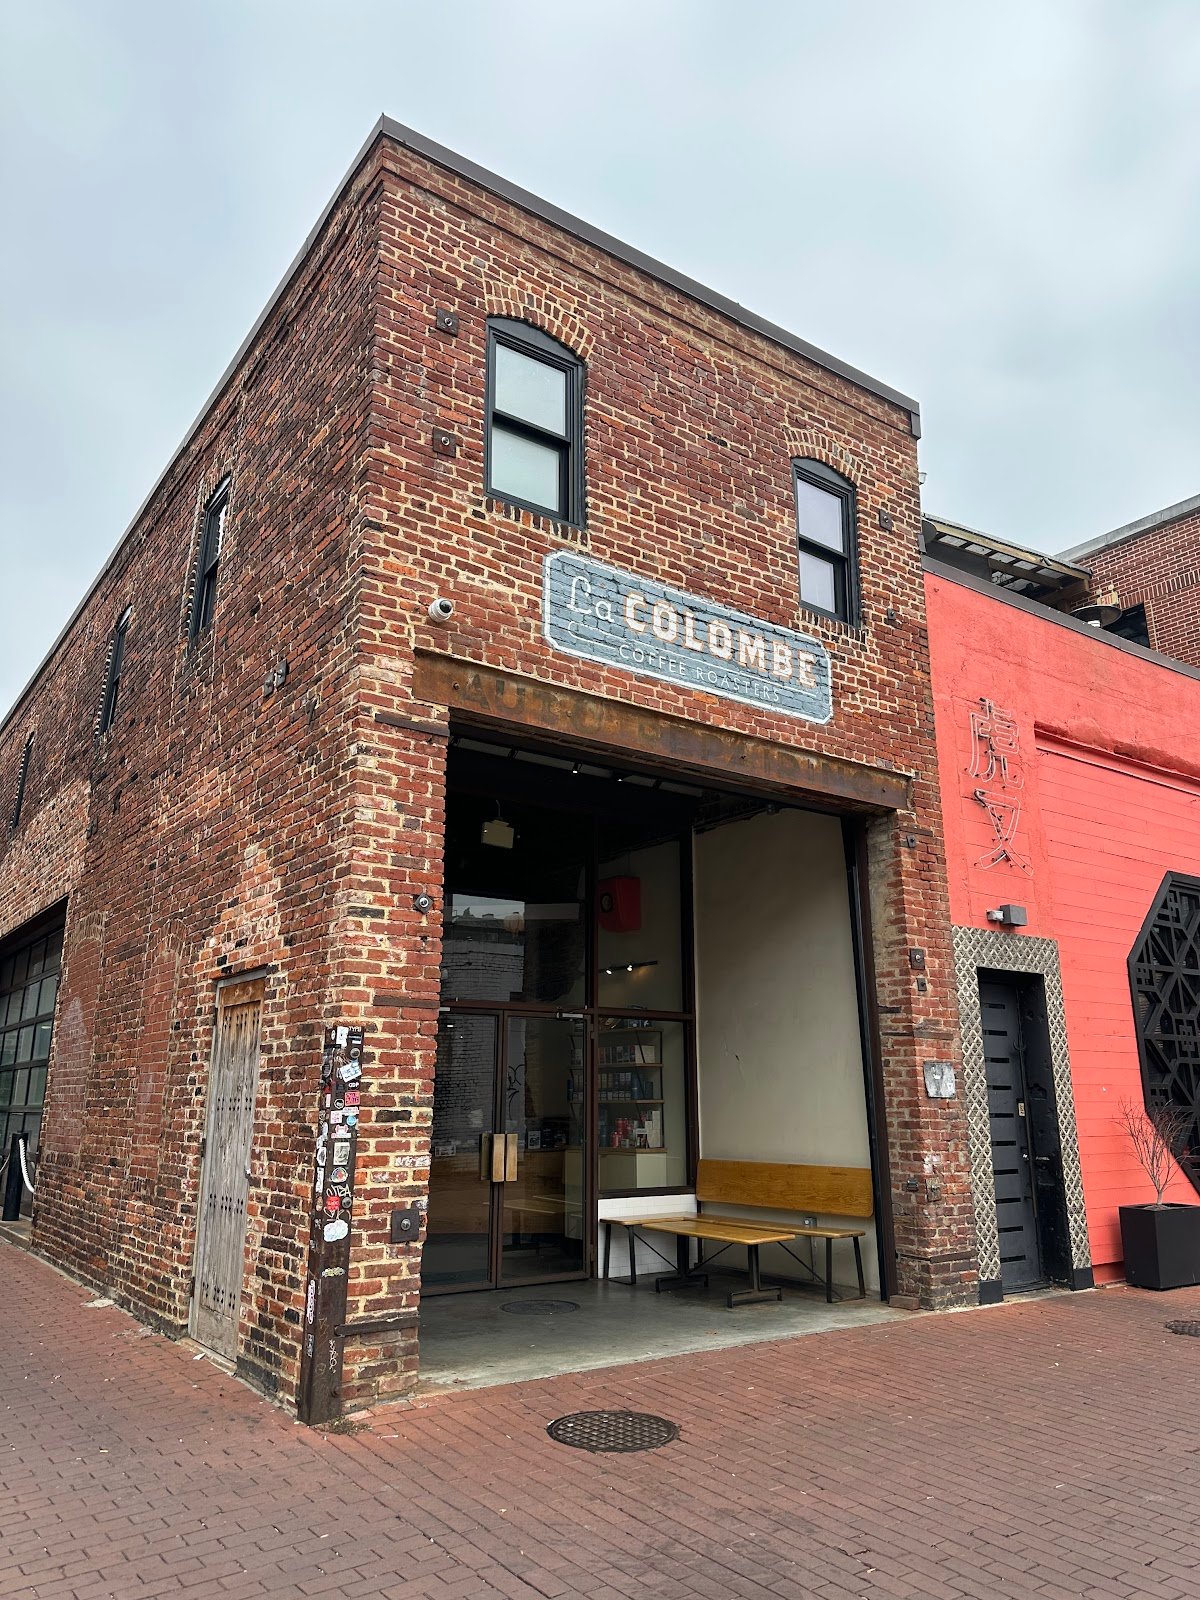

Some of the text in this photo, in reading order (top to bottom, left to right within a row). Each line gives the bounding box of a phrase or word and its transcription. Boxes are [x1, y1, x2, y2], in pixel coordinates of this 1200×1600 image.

[566, 575, 818, 689] La COLOMBE
[618, 643, 780, 702] COFFEE ROASTERS
